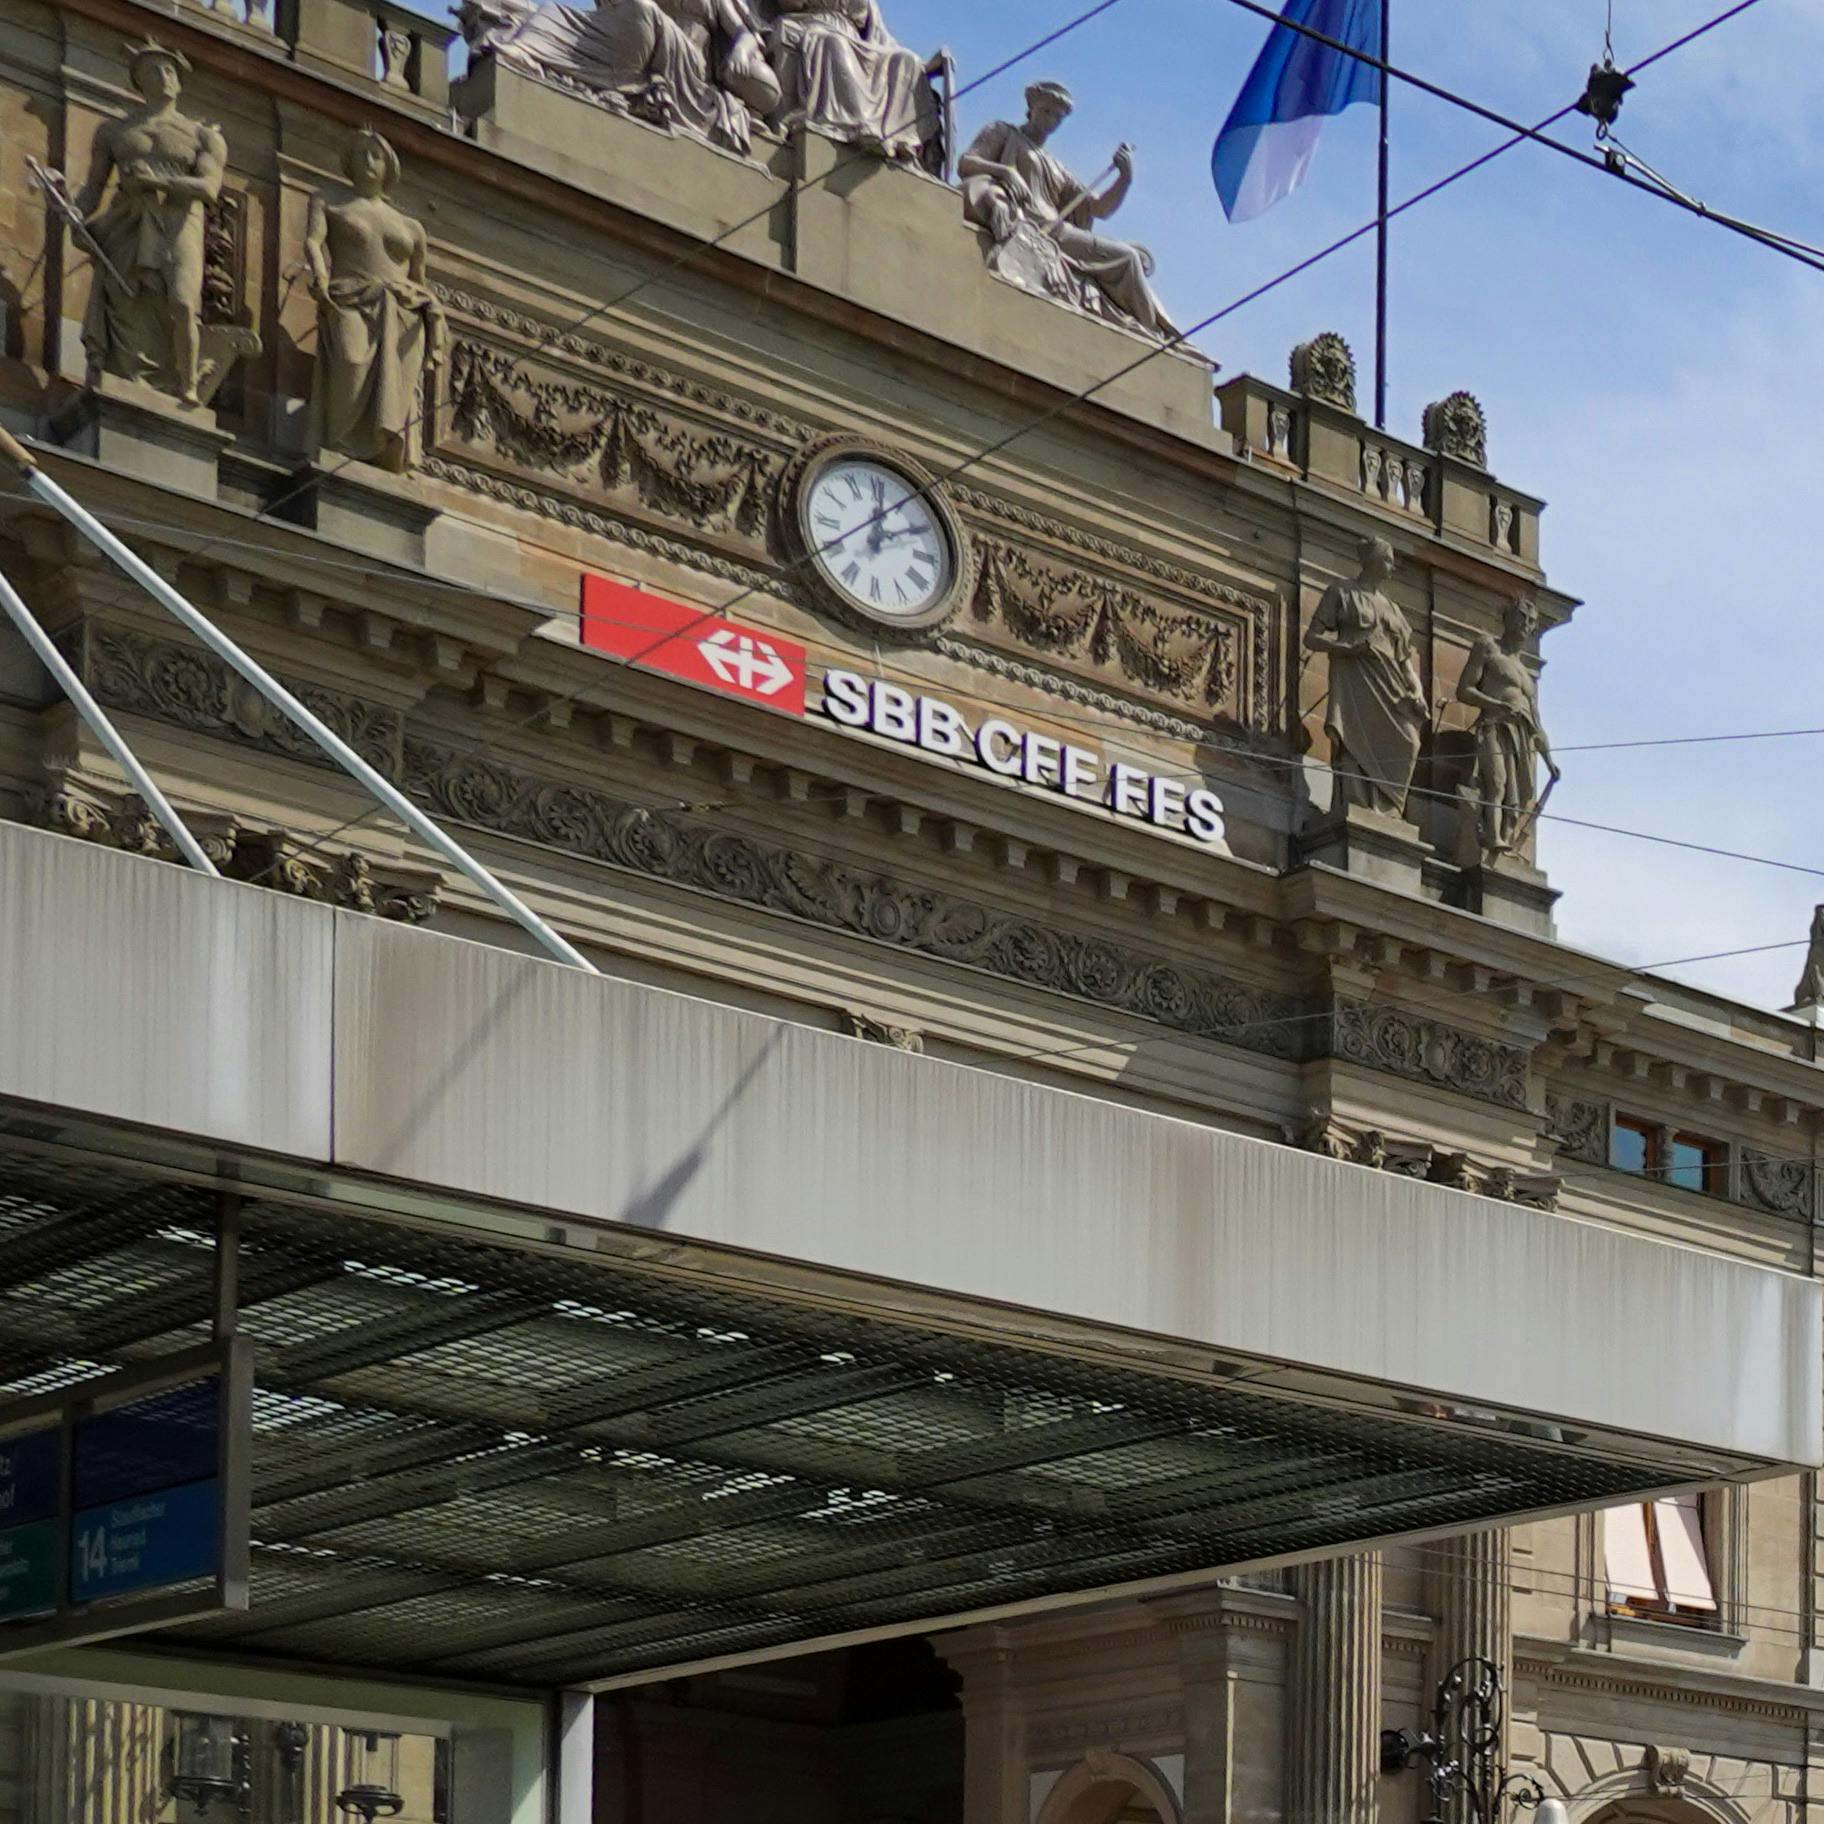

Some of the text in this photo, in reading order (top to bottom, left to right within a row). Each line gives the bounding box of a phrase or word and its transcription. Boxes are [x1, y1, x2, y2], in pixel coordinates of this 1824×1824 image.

[822, 668, 1226, 843] SBB CFF FFS
[78, 1525, 108, 1582] 14
